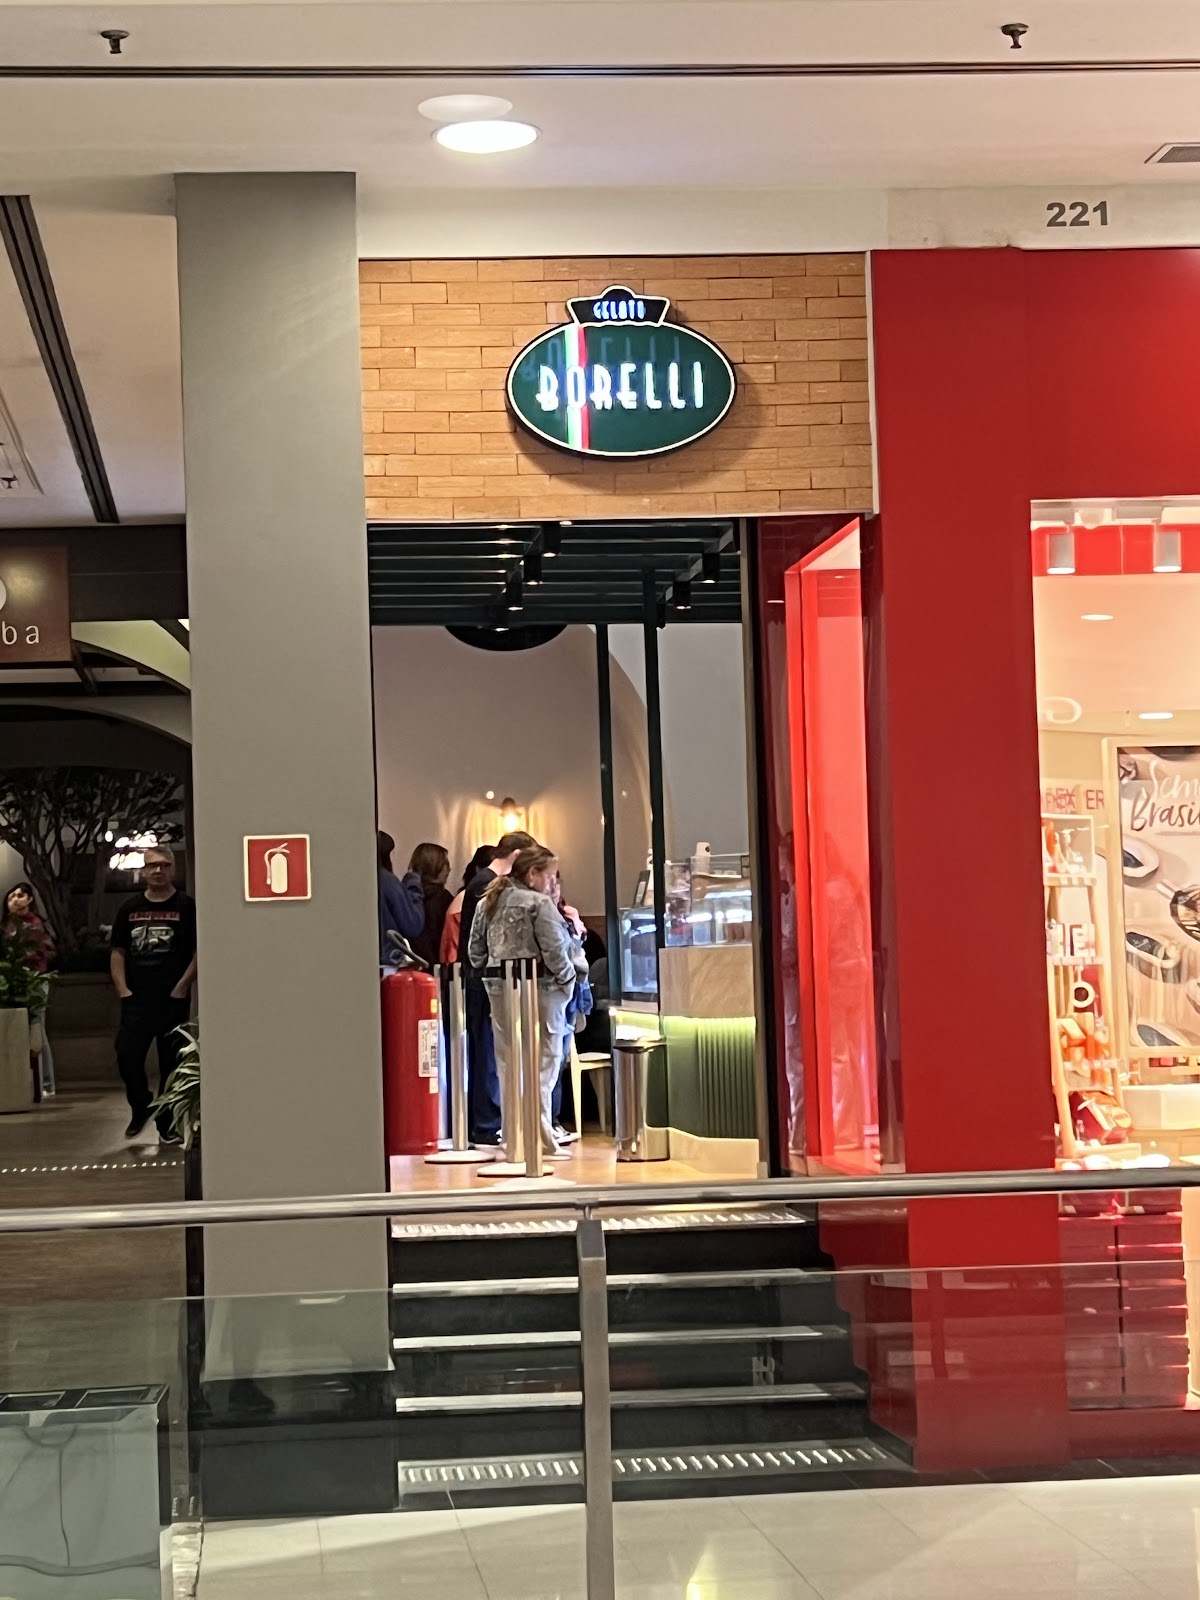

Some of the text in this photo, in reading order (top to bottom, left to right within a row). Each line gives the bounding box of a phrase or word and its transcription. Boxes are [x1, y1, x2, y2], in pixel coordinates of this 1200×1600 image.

[1046, 201, 1108, 227] 221
[535, 361, 704, 412] BORELLI
[1130, 791, 1200, 832] Brasi
